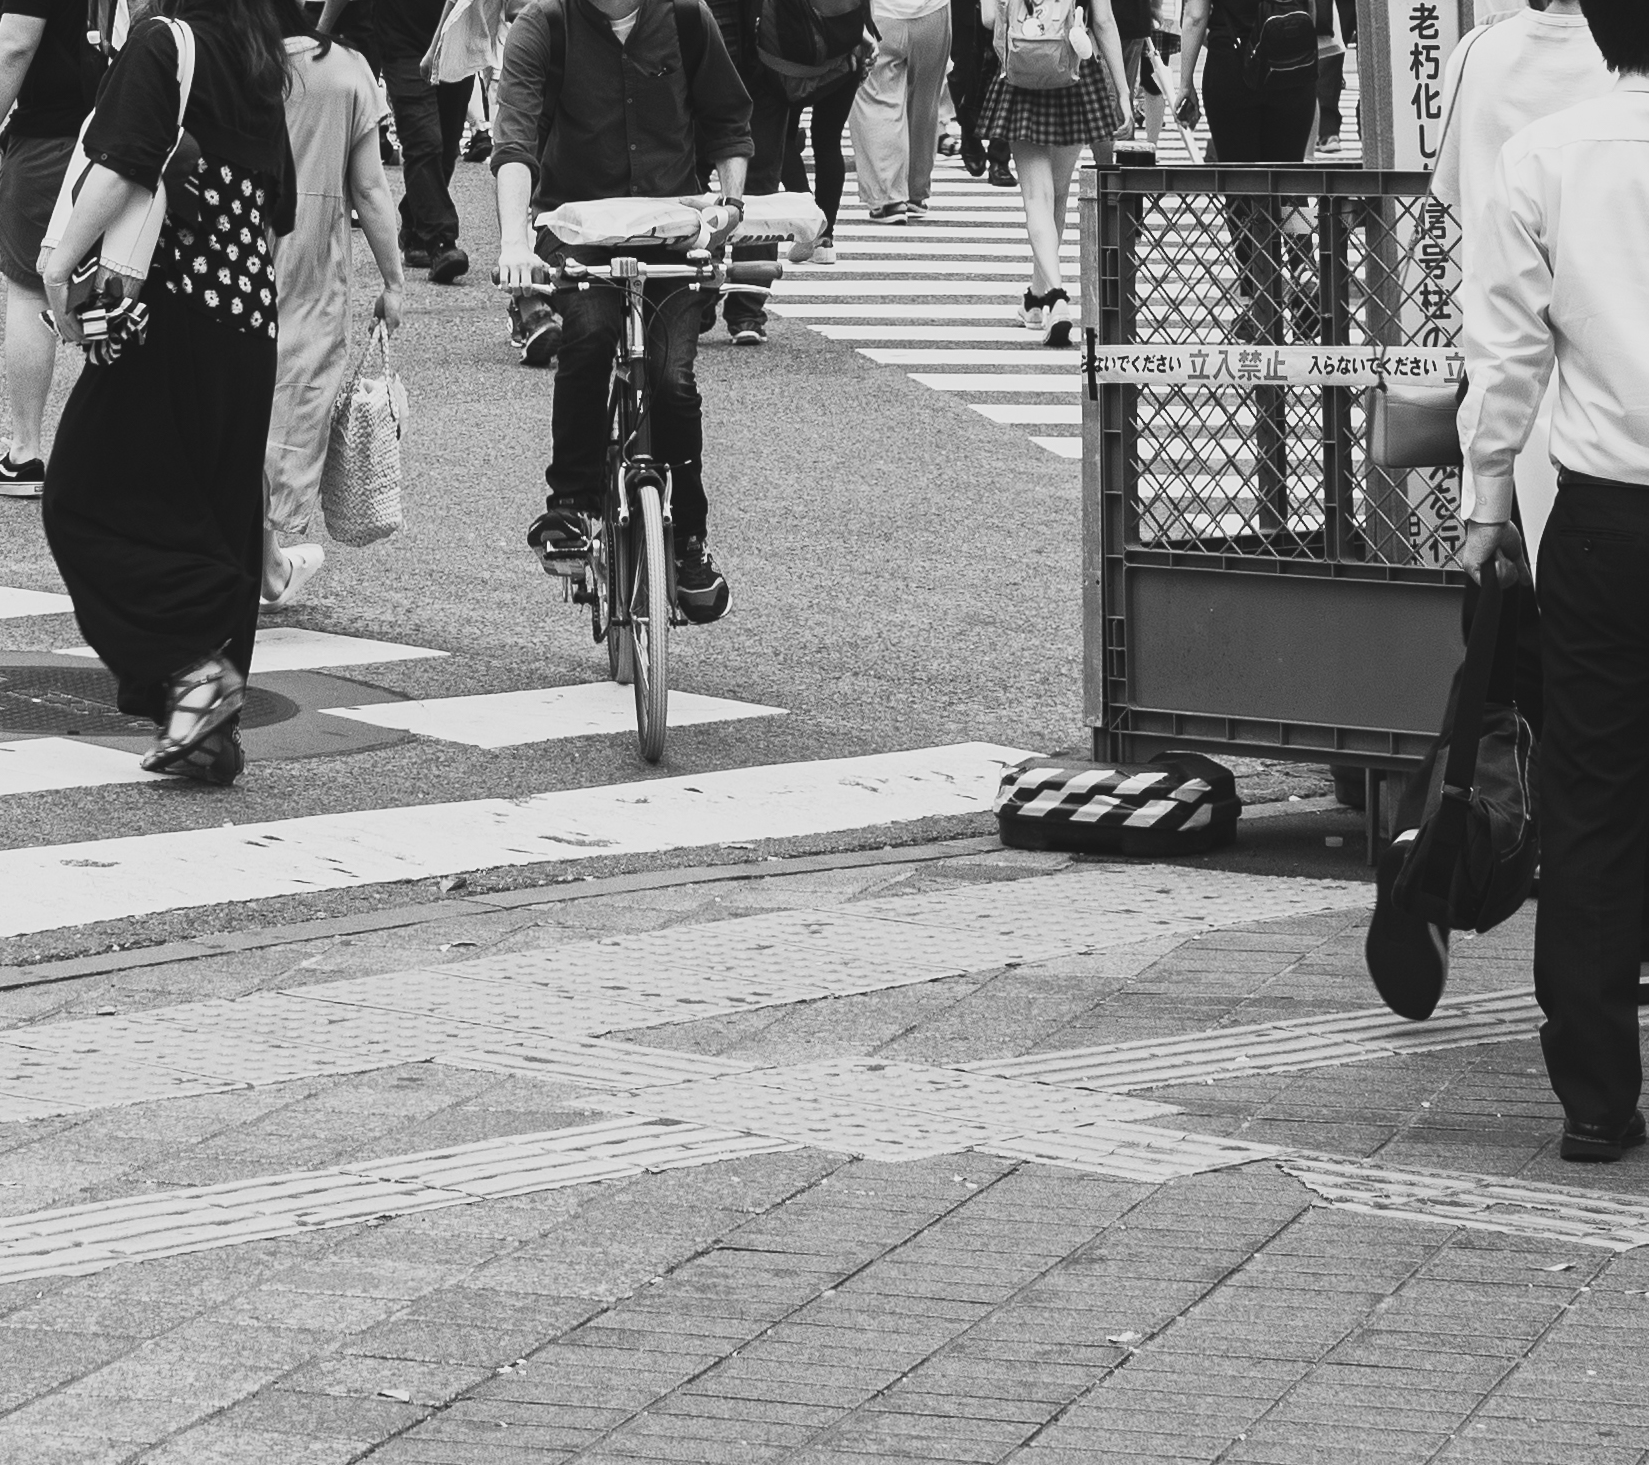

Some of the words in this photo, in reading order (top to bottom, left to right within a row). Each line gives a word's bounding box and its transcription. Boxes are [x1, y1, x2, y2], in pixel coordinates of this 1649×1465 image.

[1409, 2, 1453, 347] 老朽化し信号柱の
[1187, 349, 1288, 382] 立入禁止
[1308, 354, 1439, 375] 入らないでください
